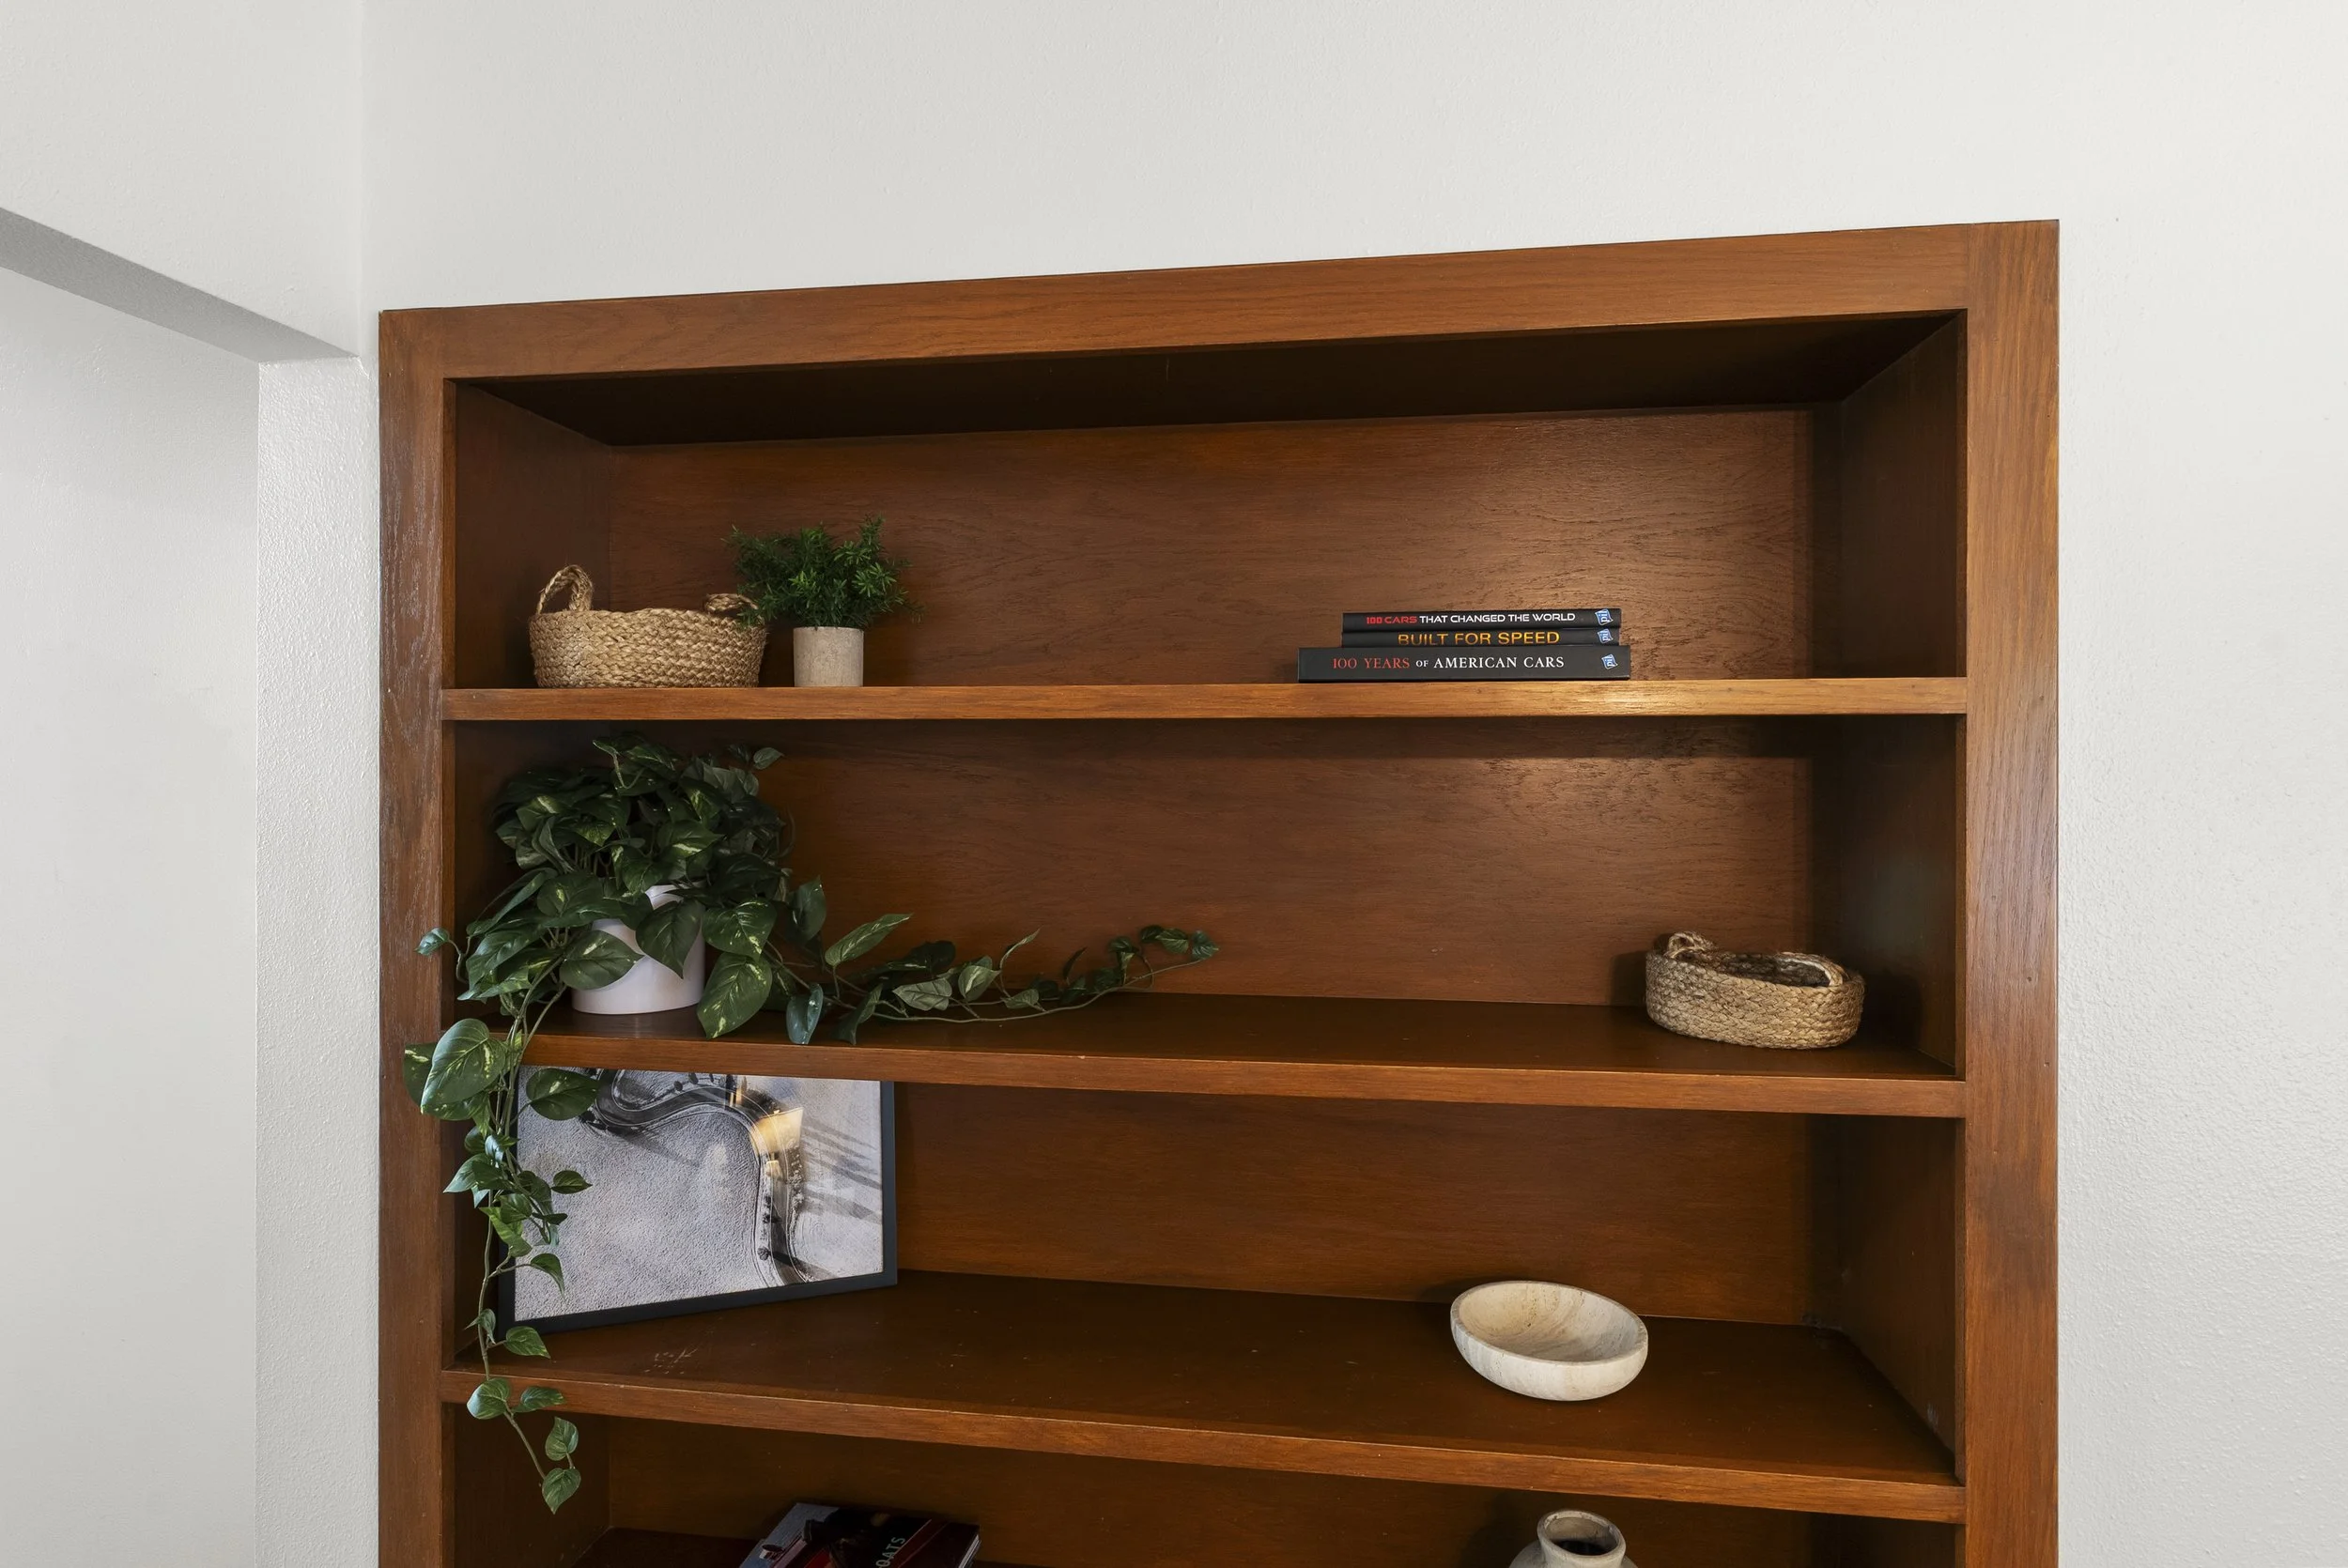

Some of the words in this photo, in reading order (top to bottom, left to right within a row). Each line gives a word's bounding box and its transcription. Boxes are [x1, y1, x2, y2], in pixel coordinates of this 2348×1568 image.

[1367, 616, 1382, 624] 100
[1384, 615, 1416, 624] CARS
[1419, 615, 1448, 623] THAT
[1450, 614, 1506, 623] CHANGED
[1507, 613, 1530, 623] THE
[1532, 613, 1576, 622] WORLD
[1398, 633, 1448, 646] BUILT
[1454, 633, 1491, 645] FOR
[1498, 631, 1560, 644] SPEED
[1333, 657, 1357, 669] 100
[1364, 657, 1411, 669] YEARS
[1433, 657, 1517, 669] AMERICAN
[1523, 656, 1565, 669] CARS
